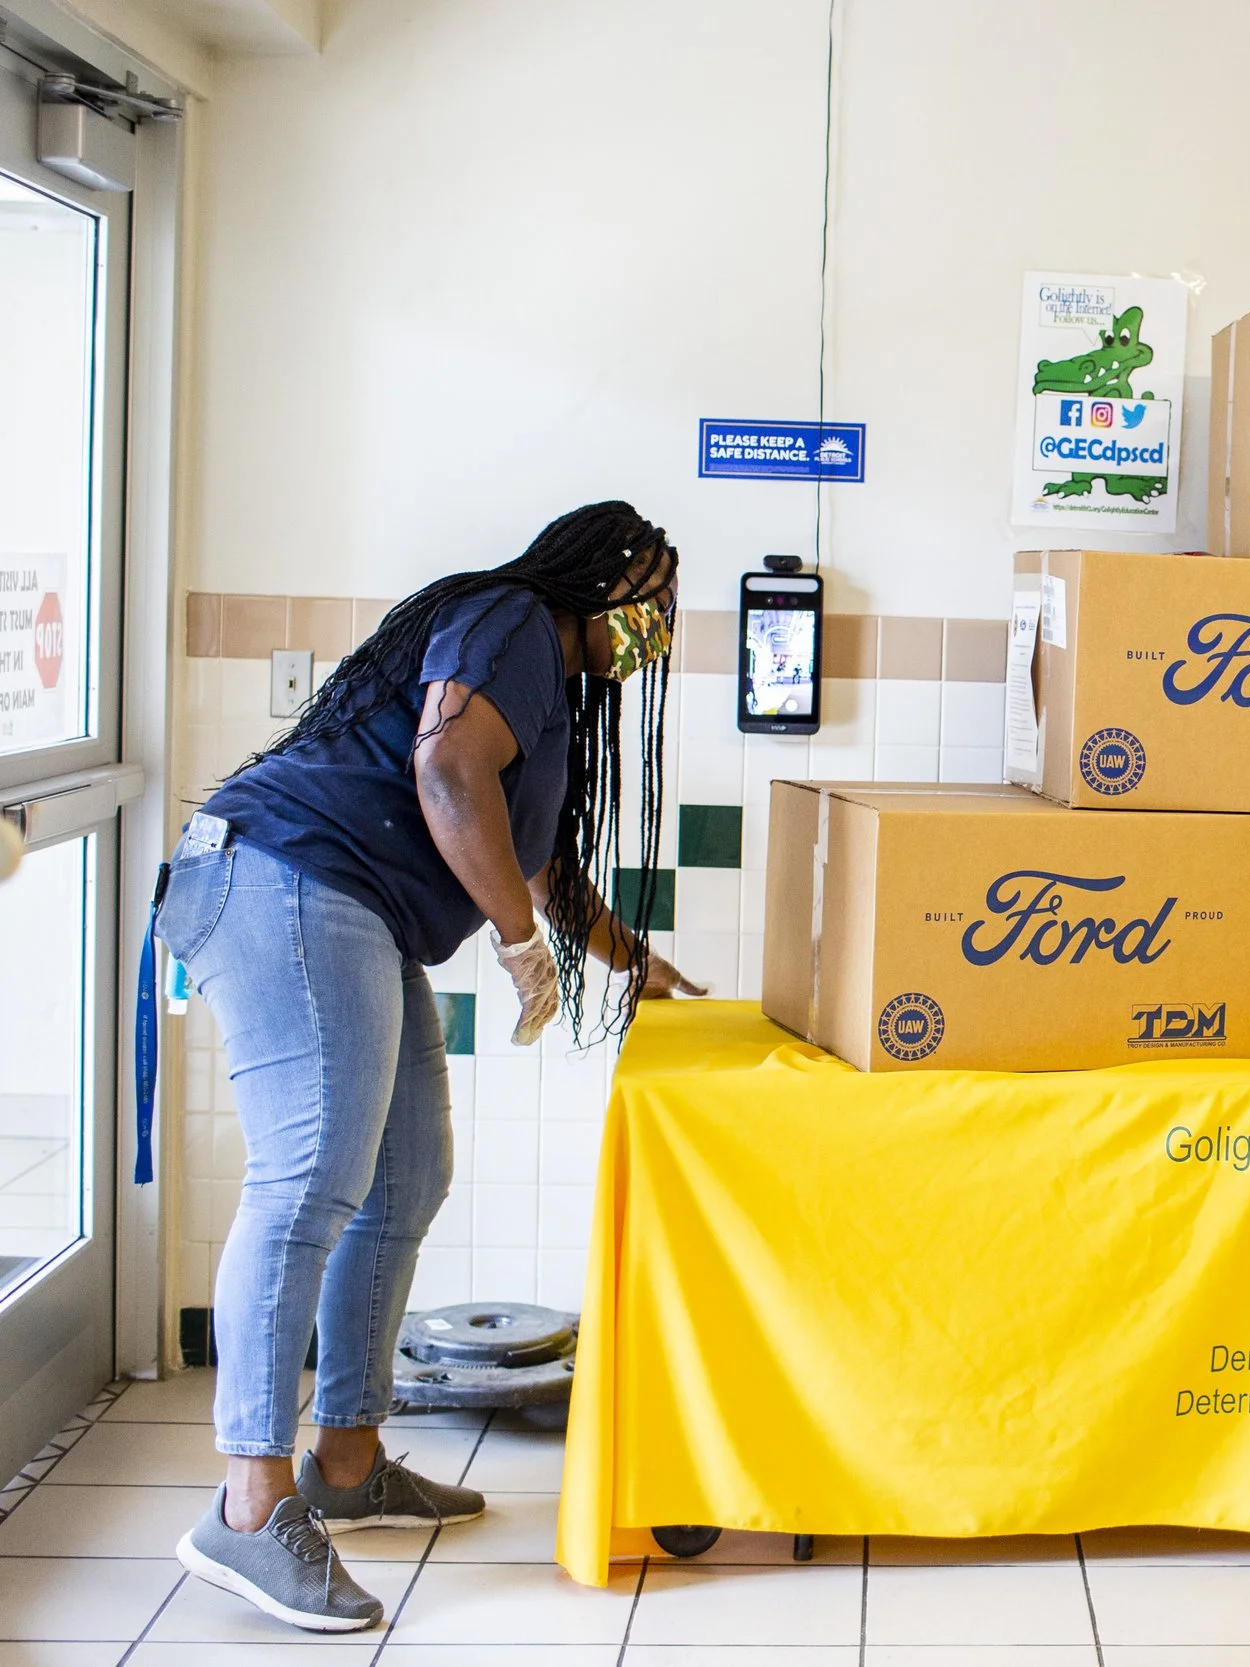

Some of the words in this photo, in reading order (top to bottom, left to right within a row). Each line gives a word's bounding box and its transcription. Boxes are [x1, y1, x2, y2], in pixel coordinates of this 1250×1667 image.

[1040, 287, 1093, 305] Golightly
[1096, 289, 1104, 304] is
[1046, 304, 1057, 312] on
[1060, 302, 1072, 313] the
[1076, 302, 1111, 315] Internet!
[1053, 312, 1084, 323] Follow
[710, 434, 758, 447] PLEASE
[760, 436, 794, 448] KEEP
[795, 437, 805, 448] A
[709, 447, 742, 459] SAFE
[744, 449, 810, 461] DISTANCE.
[1040, 437, 1164, 466] @GECdpscd
[1126, 650, 1166, 661] BUILT
[1099, 755, 1125, 769] UAW
[924, 912, 964, 922] BUILT
[961, 870, 1177, 966] Ford
[1184, 910, 1224, 921] PROUD
[898, 1019, 924, 1033] UAW
[1132, 1003, 1226, 1039] TDM
